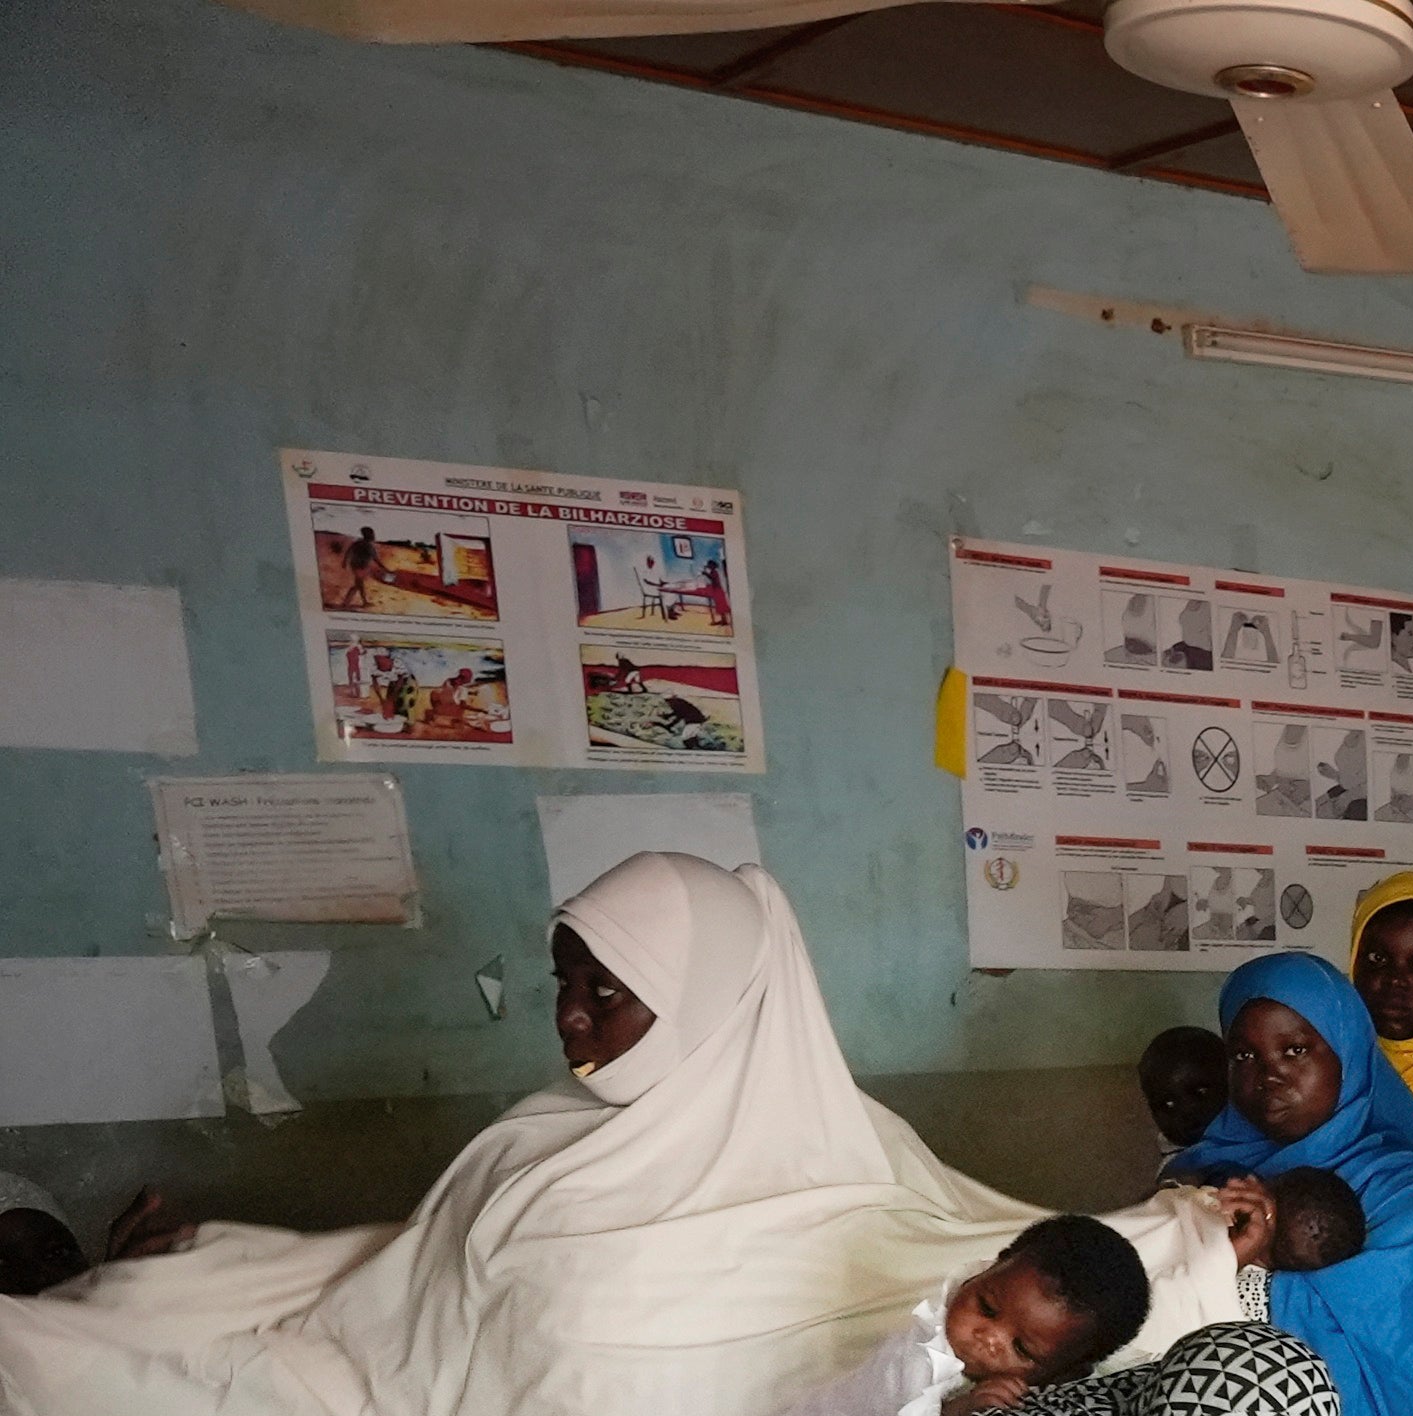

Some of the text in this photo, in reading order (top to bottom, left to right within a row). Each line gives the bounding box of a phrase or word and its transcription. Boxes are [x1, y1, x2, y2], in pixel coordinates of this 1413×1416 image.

[354, 488, 688, 529] PREVENTION DE LA BILHARZIOSE
